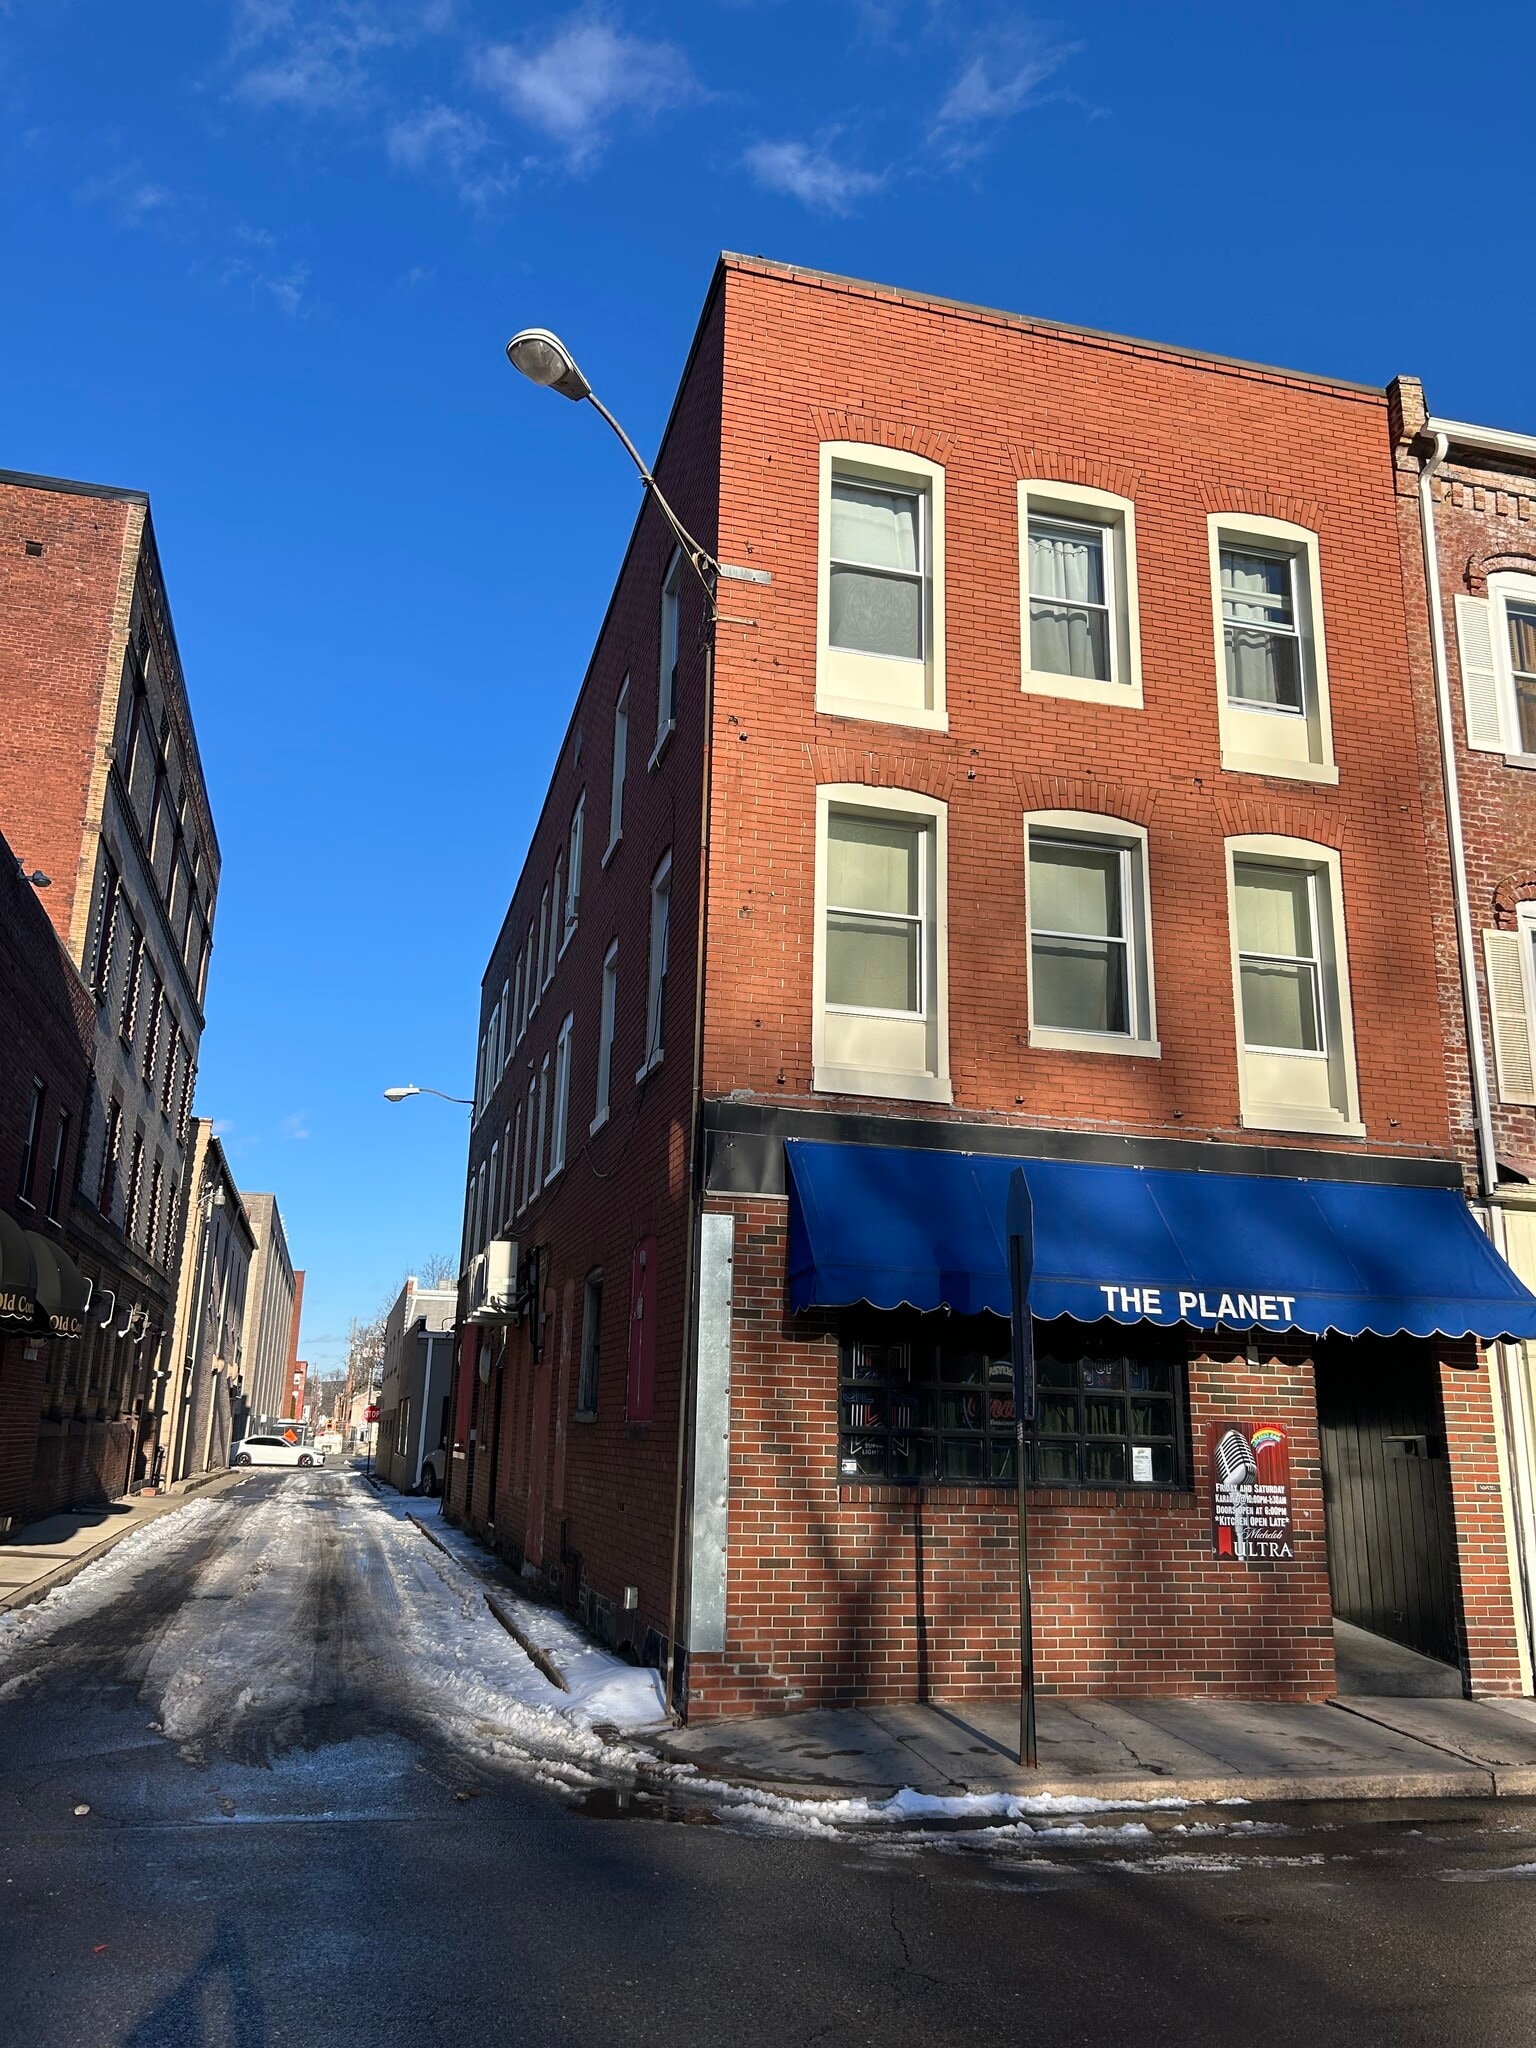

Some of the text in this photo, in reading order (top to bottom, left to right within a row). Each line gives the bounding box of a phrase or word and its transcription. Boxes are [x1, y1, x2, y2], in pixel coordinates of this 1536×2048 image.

[1099, 1285, 1296, 1321] THE PLANET
[49, 1315, 69, 1331] Old
[1095, 1358, 1138, 1375] OPN
[1215, 1483, 1285, 1494] FRIDAY AND SATURDAY
[1216, 1504, 1287, 1515] DOORS OPEN AT 6:00PM
[1249, 1516, 1268, 1526] OPEN
[1242, 1527, 1283, 1540] Michelob
[1233, 1541, 1293, 1558] ULTRA
